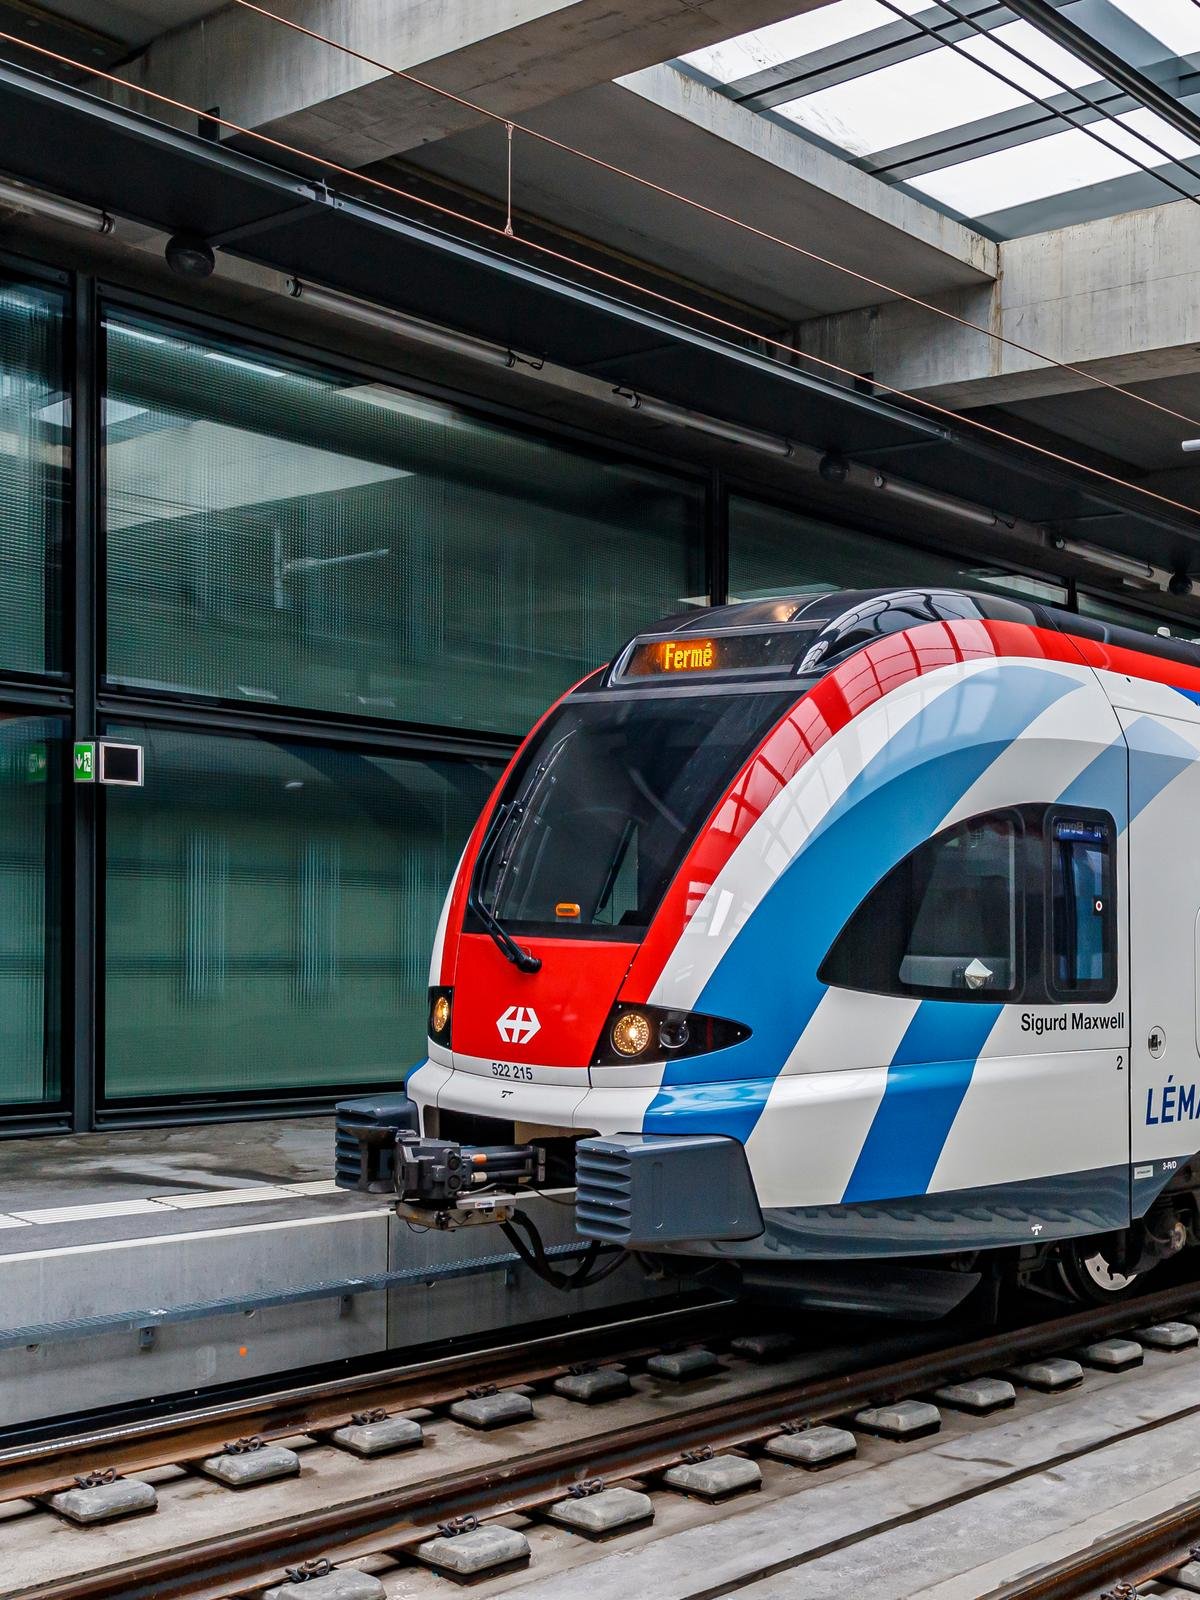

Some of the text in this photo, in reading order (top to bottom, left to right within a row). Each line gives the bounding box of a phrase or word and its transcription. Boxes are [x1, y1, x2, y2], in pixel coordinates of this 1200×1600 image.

[665, 642, 712, 669] Fermé
[1021, 1012, 1124, 1035] Sigurd Maxwell
[492, 1063, 533, 1080] 522 215
[1116, 1055, 1123, 1070] 2
